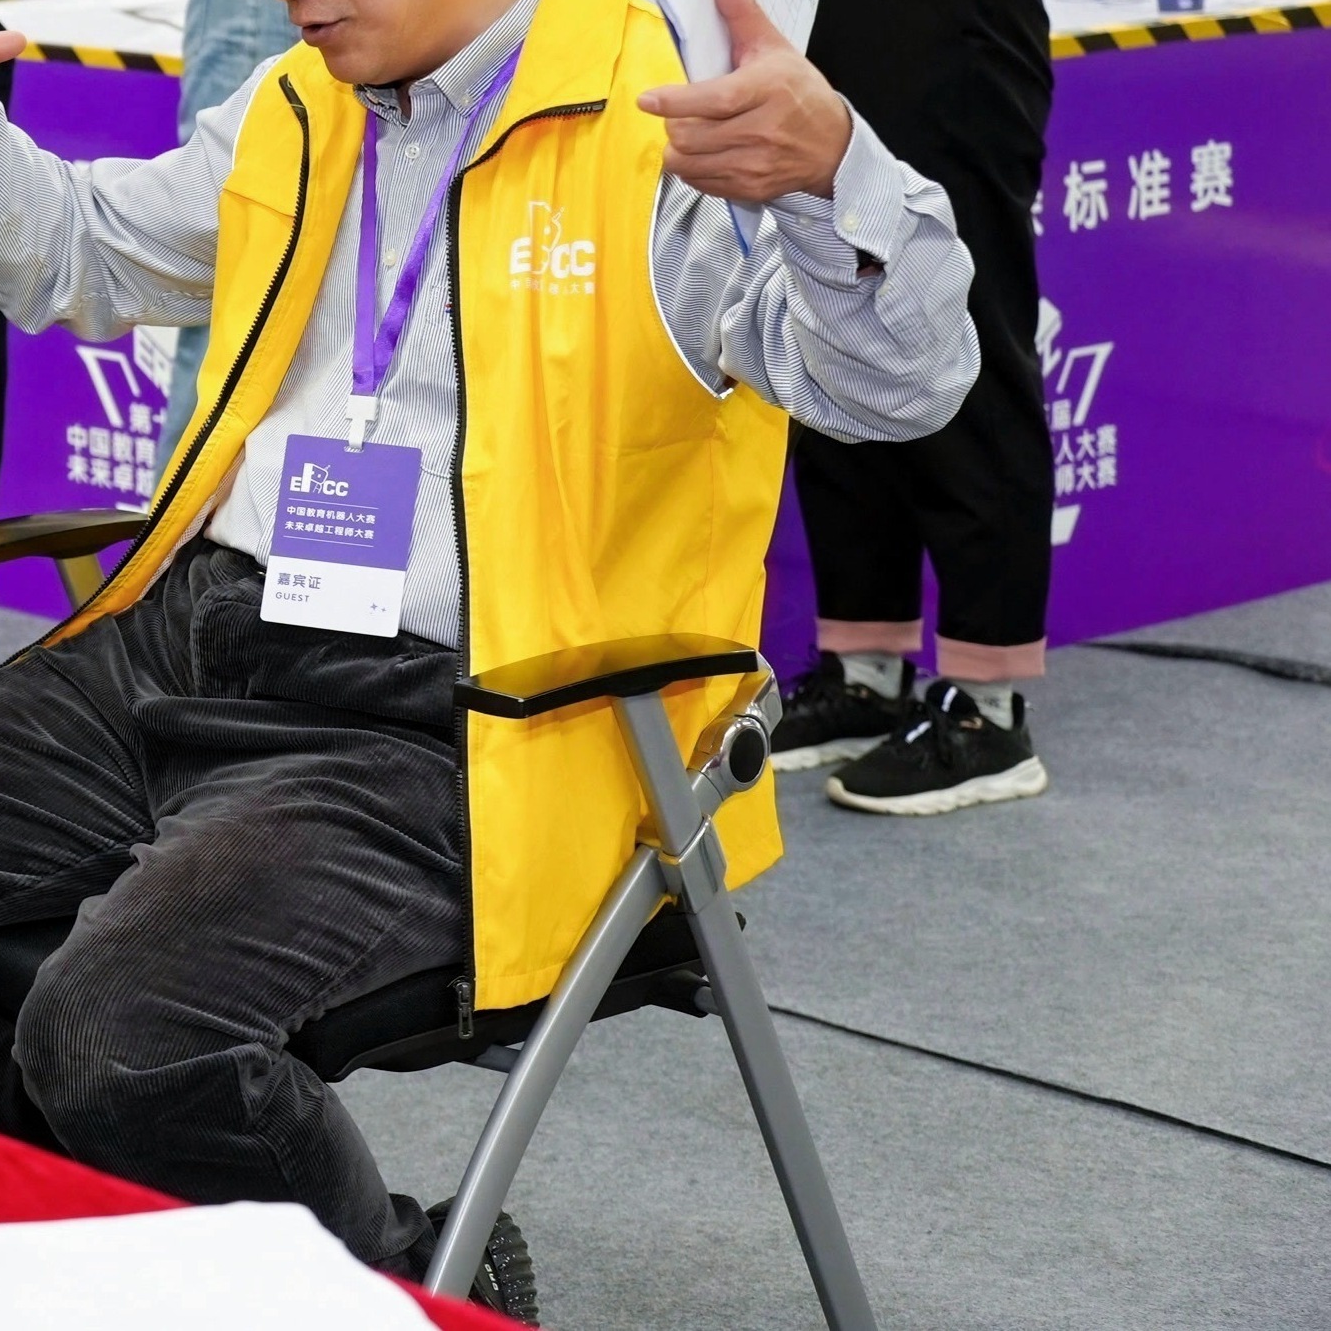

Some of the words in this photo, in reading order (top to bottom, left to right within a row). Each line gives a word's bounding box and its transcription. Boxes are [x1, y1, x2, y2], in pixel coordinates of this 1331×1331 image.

[1030, 139, 1234, 237] 标准赛
[286, 505, 376, 525] 中国教育机器人大赛
[284, 521, 375, 540] 未来卓越工程师大赛
[276, 572, 322, 590] 嘉宾证
[274, 592, 310, 603] GUEST
